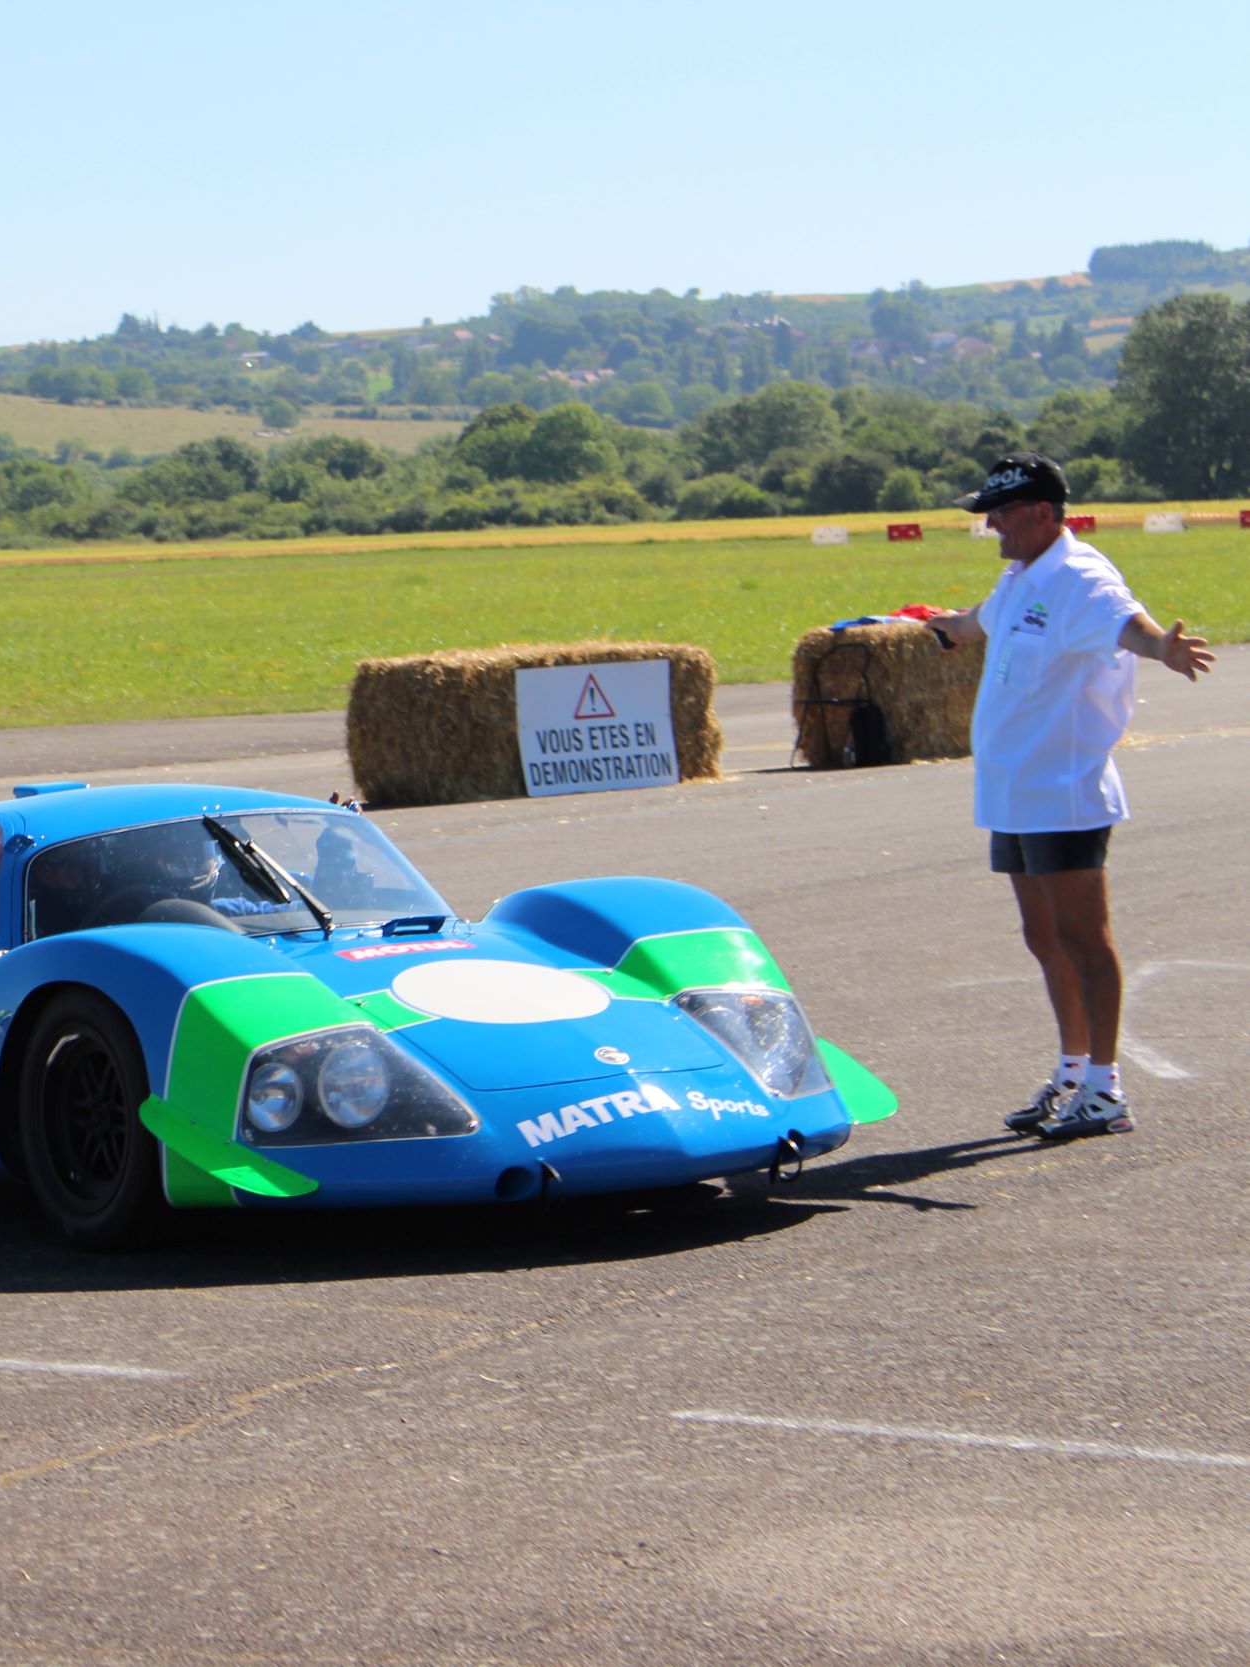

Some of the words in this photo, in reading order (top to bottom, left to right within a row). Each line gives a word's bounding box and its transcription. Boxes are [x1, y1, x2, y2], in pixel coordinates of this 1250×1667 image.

[536, 727, 584, 754] VOUS
[588, 724, 630, 750] ETES
[634, 722, 657, 747] EN
[529, 752, 673, 787] DEMONSTRATION
[350, 940, 468, 960] MOTUL
[516, 1083, 682, 1148] MATRA
[686, 1090, 770, 1120] Sports
